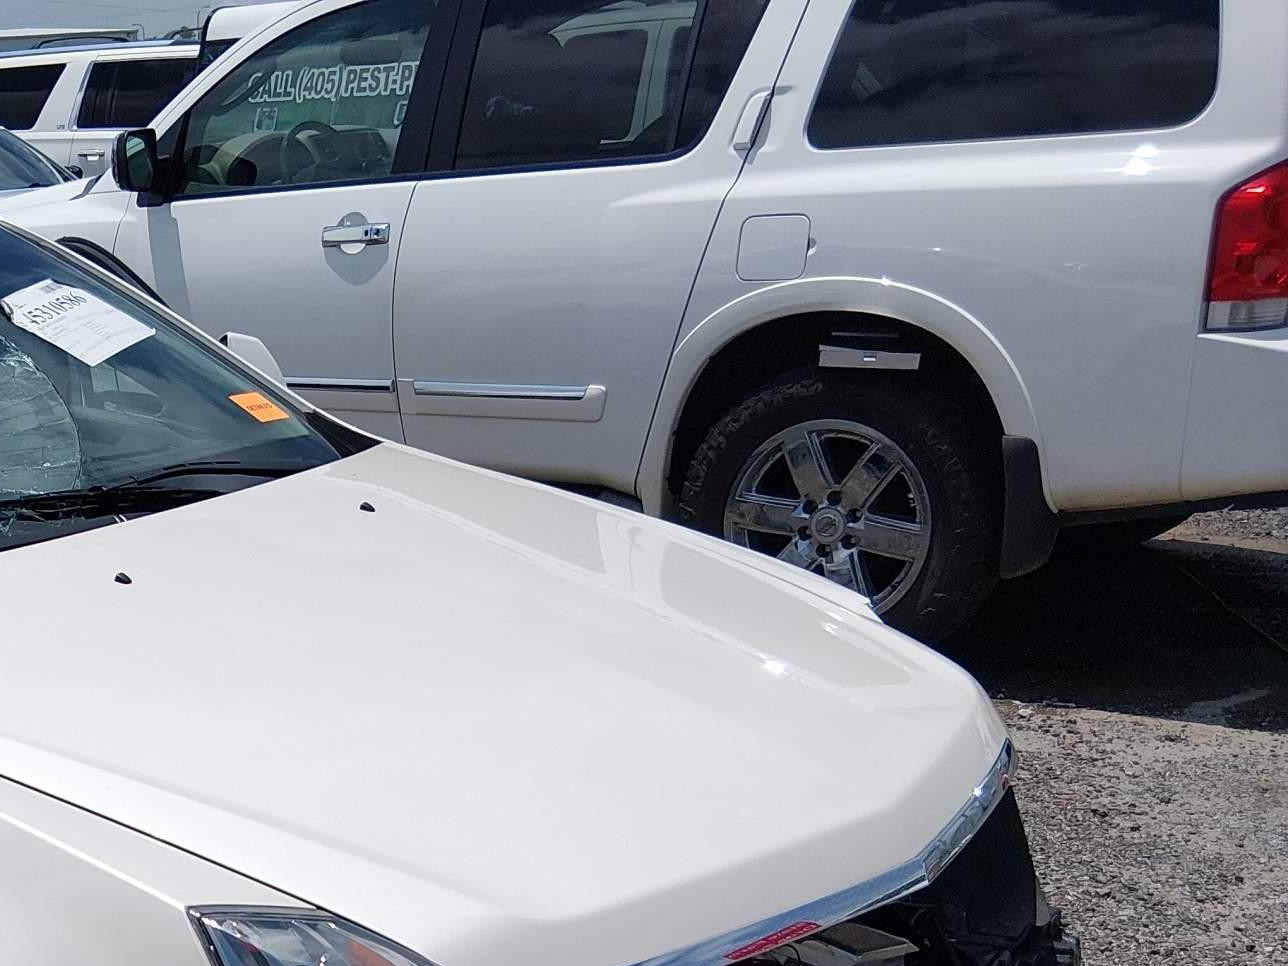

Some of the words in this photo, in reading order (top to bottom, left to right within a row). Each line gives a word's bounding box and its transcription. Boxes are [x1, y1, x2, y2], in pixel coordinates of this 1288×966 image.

[297, 66, 343, 103] (405)
[343, 61, 420, 97] PEST-P
[23, 291, 88, 325] 45310586
